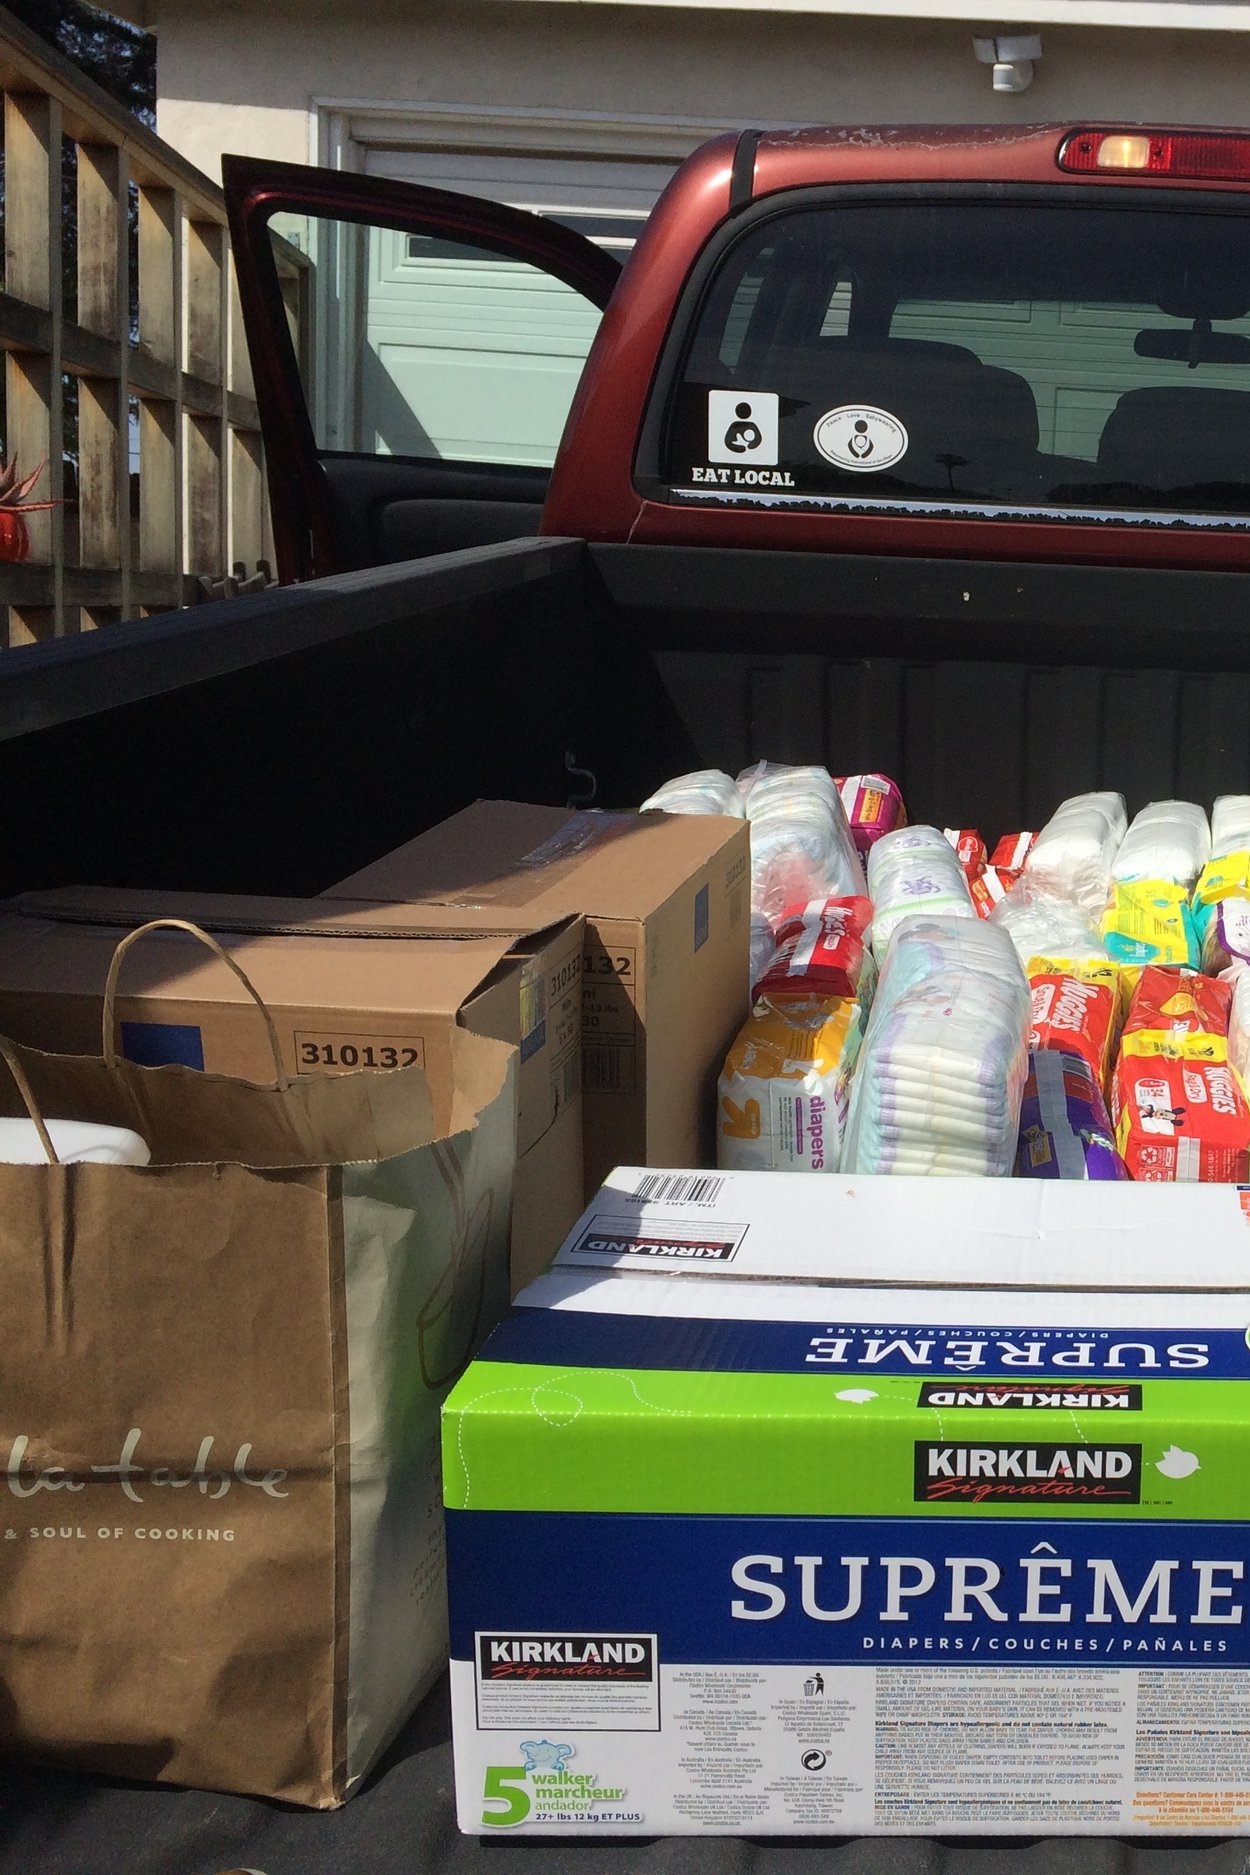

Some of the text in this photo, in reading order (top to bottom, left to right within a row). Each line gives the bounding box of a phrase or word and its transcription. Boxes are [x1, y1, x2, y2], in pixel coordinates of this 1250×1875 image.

[691, 467, 795, 487] EAT LOCAL
[583, 957, 631, 975] 132
[1050, 977, 1099, 1032] HUGGIES
[301, 1043, 418, 1069] 310132
[1203, 1066, 1237, 1116] HUGGIES
[806, 1095, 826, 1169] diapers
[587, 1240, 723, 1259] KIRKLAND
[1031, 1331, 1109, 1339] DIAPERS
[805, 1337, 1209, 1371] SUPRÊME
[928, 1390, 1130, 1408] KIRKLAND
[6, 1427, 289, 1503] la table
[927, 1448, 1133, 1479] KIRKLAND
[926, 1476, 1131, 1503] Signature
[4, 1527, 236, 1542] & SOUL OF COOKING
[730, 1541, 1245, 1625] SUPRÊME
[490, 1641, 646, 1663] KIRKLAND
[863, 1636, 1228, 1652] DIAPERS COUCHES PAÑALES
[490, 1661, 646, 1681] Signature
[481, 1766, 593, 1826] 5 walker
[535, 1786, 624, 1798] marcheur
[535, 1800, 591, 1811] andador
[535, 1812, 554, 1821] 27+
[556, 1812, 572, 1821] lbs
[574, 1813, 585, 1821] 12
[587, 1812, 599, 1823] kg
[615, 1813, 640, 1821] PLUS
